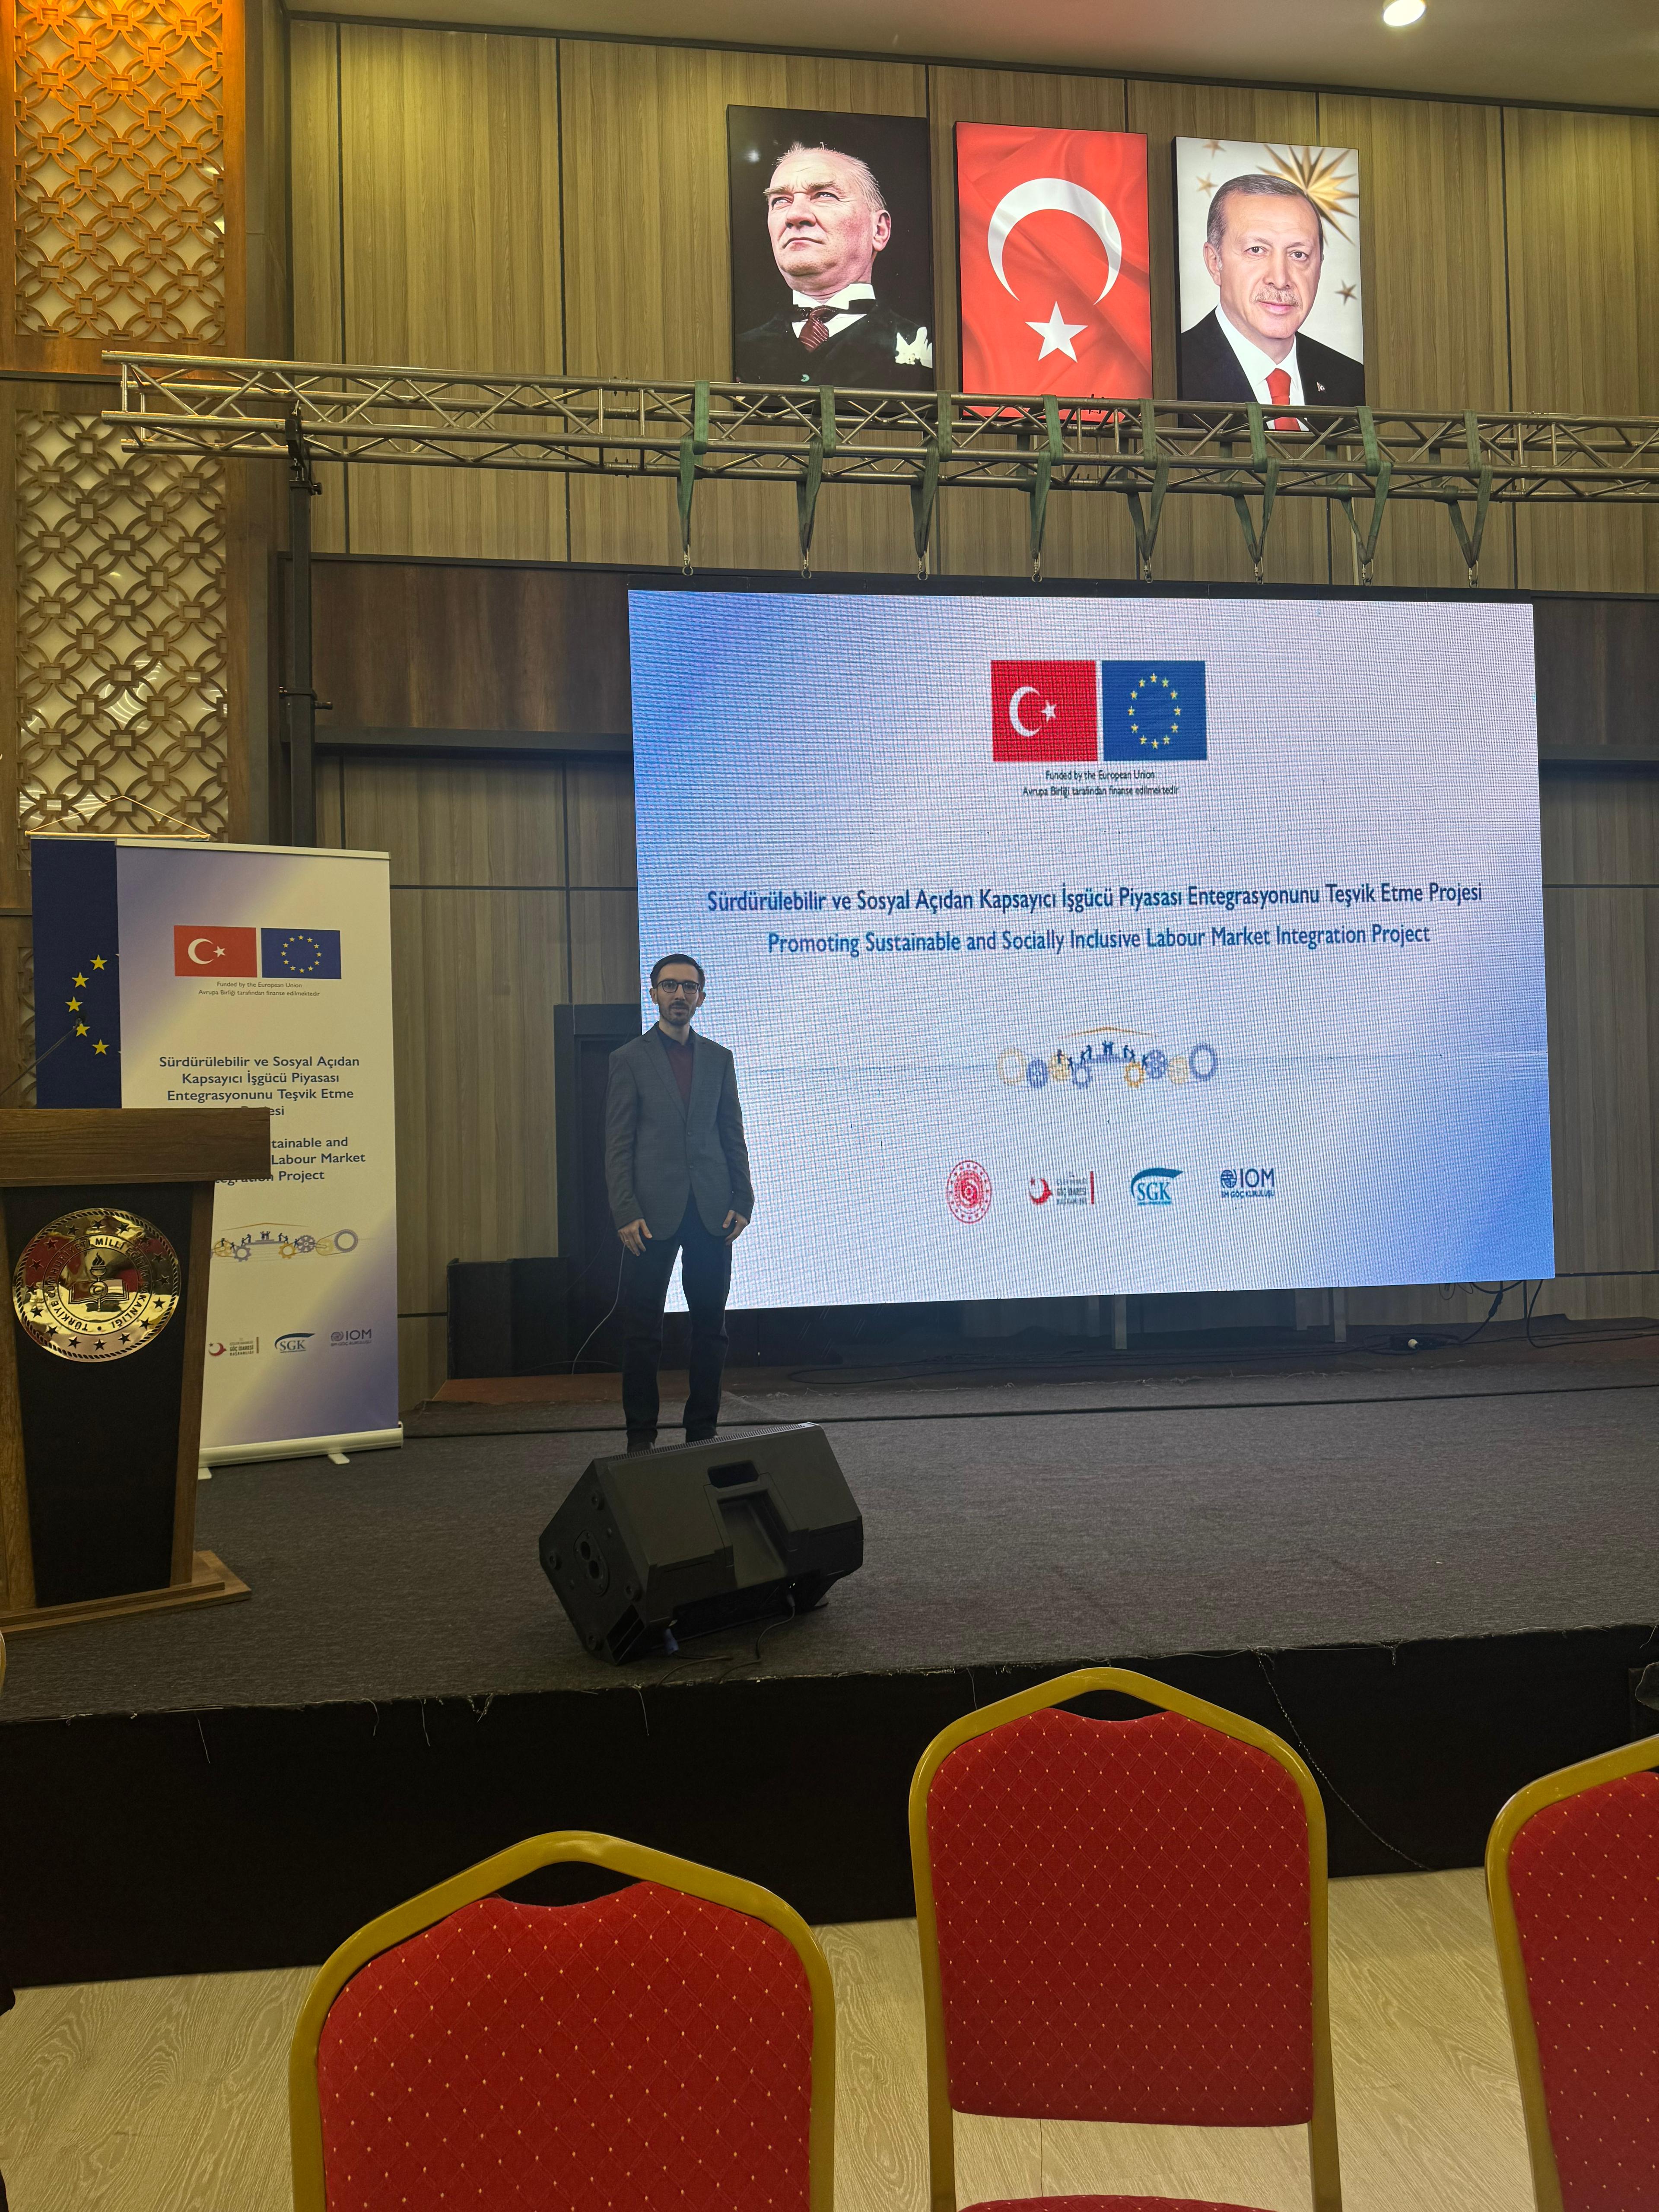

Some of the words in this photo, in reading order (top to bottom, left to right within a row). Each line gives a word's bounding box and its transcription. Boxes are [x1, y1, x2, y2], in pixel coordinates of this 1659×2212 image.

[1046, 770, 1071, 779] Funded
[1074, 770, 1082, 782] by
[1084, 770, 1095, 779] the
[1098, 770, 1131, 782] European
[1134, 770, 1155, 779] Union
[1023, 787, 1048, 798] Avrupa
[1109, 786, 1133, 795] finanse
[1135, 785, 1179, 795] edilmektedir
[707, 890, 826, 911] Sürdürülebilir
[833, 894, 851, 910] ve
[858, 890, 910, 915] Sosyal
[915, 889, 973, 914] Açıdan
[980, 889, 1056, 914] Kapsayıcı
[1063, 883, 1113, 913] İşgücü
[1119, 887, 1182, 911] Piyasası
[1188, 885, 1319, 910] Entegrasyonunu
[1325, 884, 1376, 907] Teşvik
[1381, 883, 1423, 902] Etme
[1430, 883, 1482, 906] Projesi
[769, 933, 859, 958] Promoting
[866, 931, 960, 952] Sustainable
[967, 931, 996, 951] and
[1003, 930, 1064, 954] Socially
[1071, 929, 1140, 949] Inclusive
[1147, 927, 1205, 947] Labour
[1211, 926, 1271, 946] Market
[1277, 925, 1366, 950] Integration
[1372, 923, 1430, 948] Project
[159, 1056, 249, 1068] Sürdürülebilir
[254, 1058, 268, 1066] ve
[273, 1056, 312, 1069] Sosyal
[317, 1057, 359, 1068] Açıdan
[182, 1073, 242, 1086] Kapsayıcı
[248, 1071, 287, 1086] İşgücü
[292, 1072, 339, 1085] Piyasası
[167, 1090, 273, 1103] Entegrasyonunu
[277, 1089, 316, 1102] Teşvik
[321, 1089, 354, 1099] Etme
[272, 1138, 321, 1148] tainable
[326, 1137, 348, 1147] and
[271, 1154, 317, 1165] Labour
[321, 1153, 365, 1163] Market
[279, 1171, 324, 1183] Project
[1240, 1168, 1274, 1188] IOM
[1138, 1182, 1171, 1200] SGK
[51, 1300, 88, 1331] TÜRKİYE
[346, 1329, 372, 1341] IOM
[280, 1340, 305, 1351] SGK
